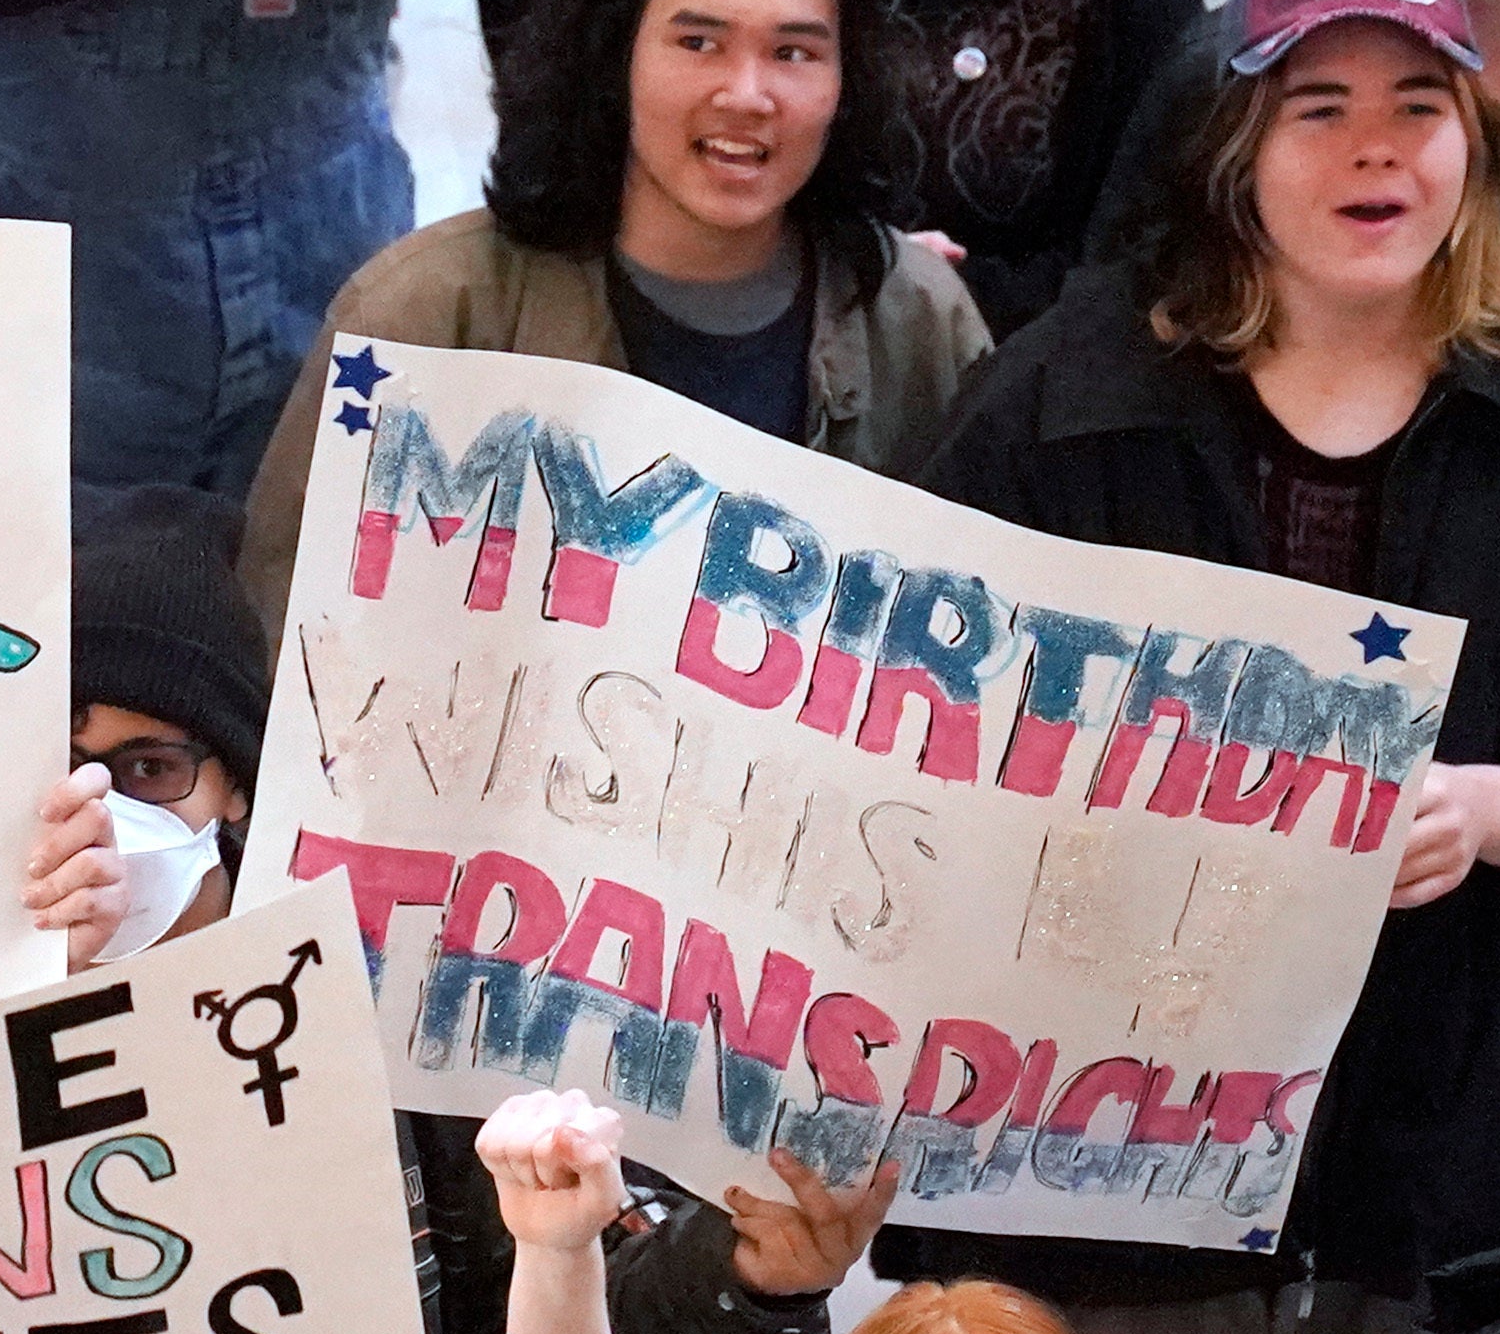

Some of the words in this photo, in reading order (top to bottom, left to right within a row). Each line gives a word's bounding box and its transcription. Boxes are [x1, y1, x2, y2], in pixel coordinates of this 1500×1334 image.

[348, 406, 718, 629] MY
[675, 488, 1442, 855] BIRTHDAY
[291, 828, 900, 1191] TRANS
